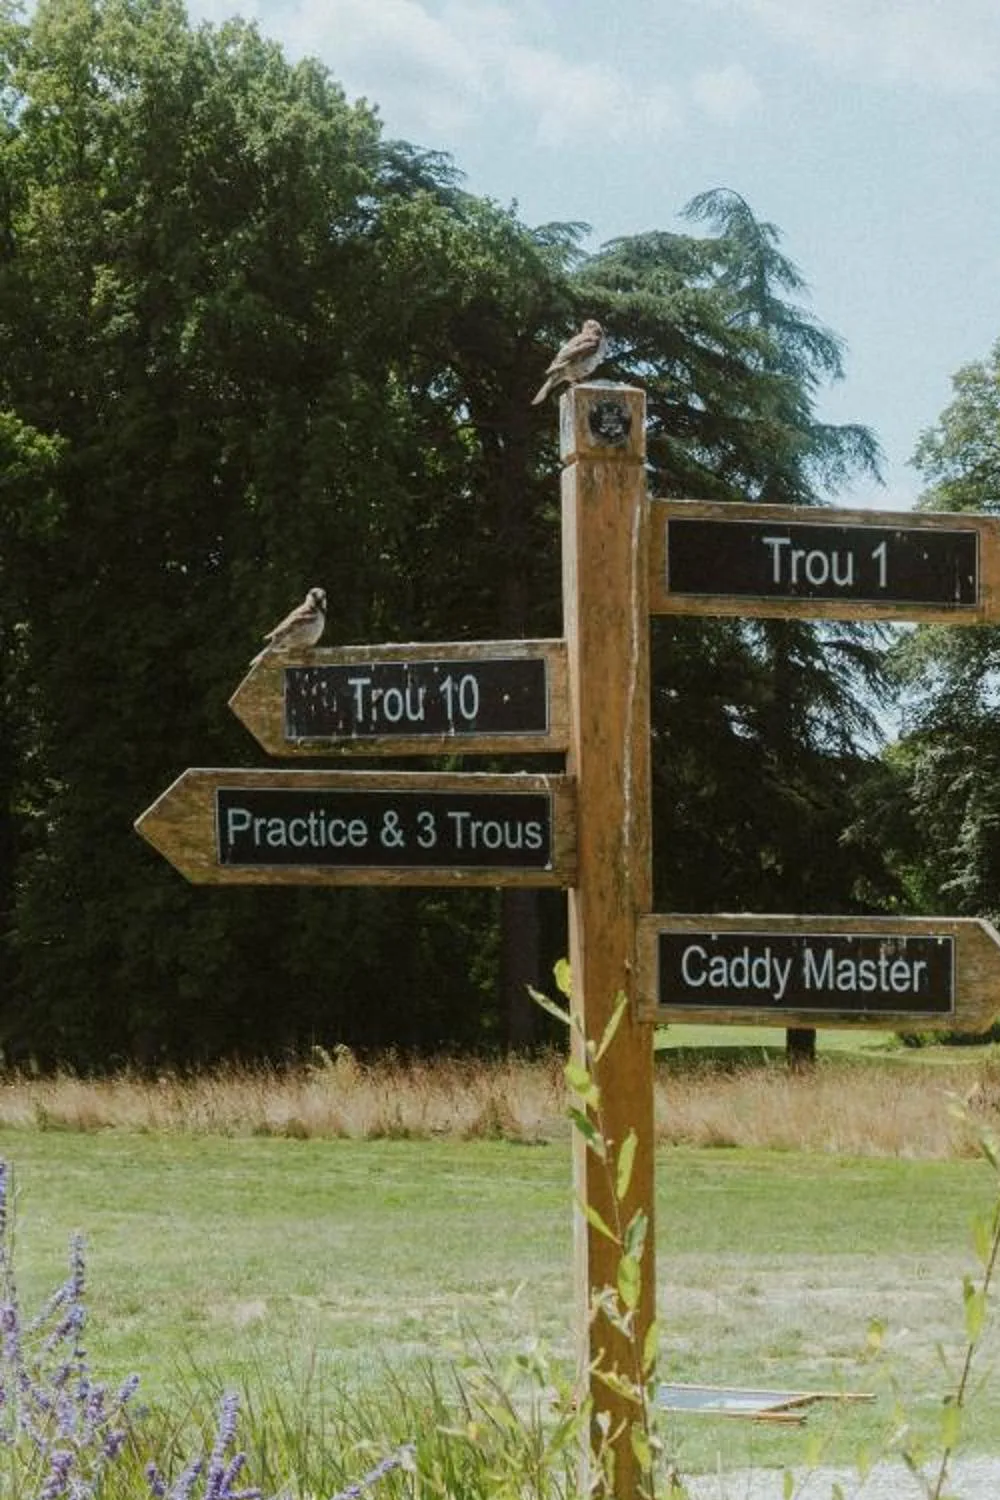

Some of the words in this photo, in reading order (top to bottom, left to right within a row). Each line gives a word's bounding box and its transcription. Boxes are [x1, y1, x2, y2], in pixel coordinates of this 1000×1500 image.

[763, 537, 853, 585] Trou
[872, 541, 887, 587] 1
[348, 677, 426, 722] Trou
[439, 674, 479, 721] 10
[227, 808, 368, 847] Practice
[380, 810, 405, 848] &
[416, 811, 437, 848] 3
[448, 811, 543, 849] Trous
[681, 945, 792, 1000] Caddy
[803, 943, 927, 992] Master
